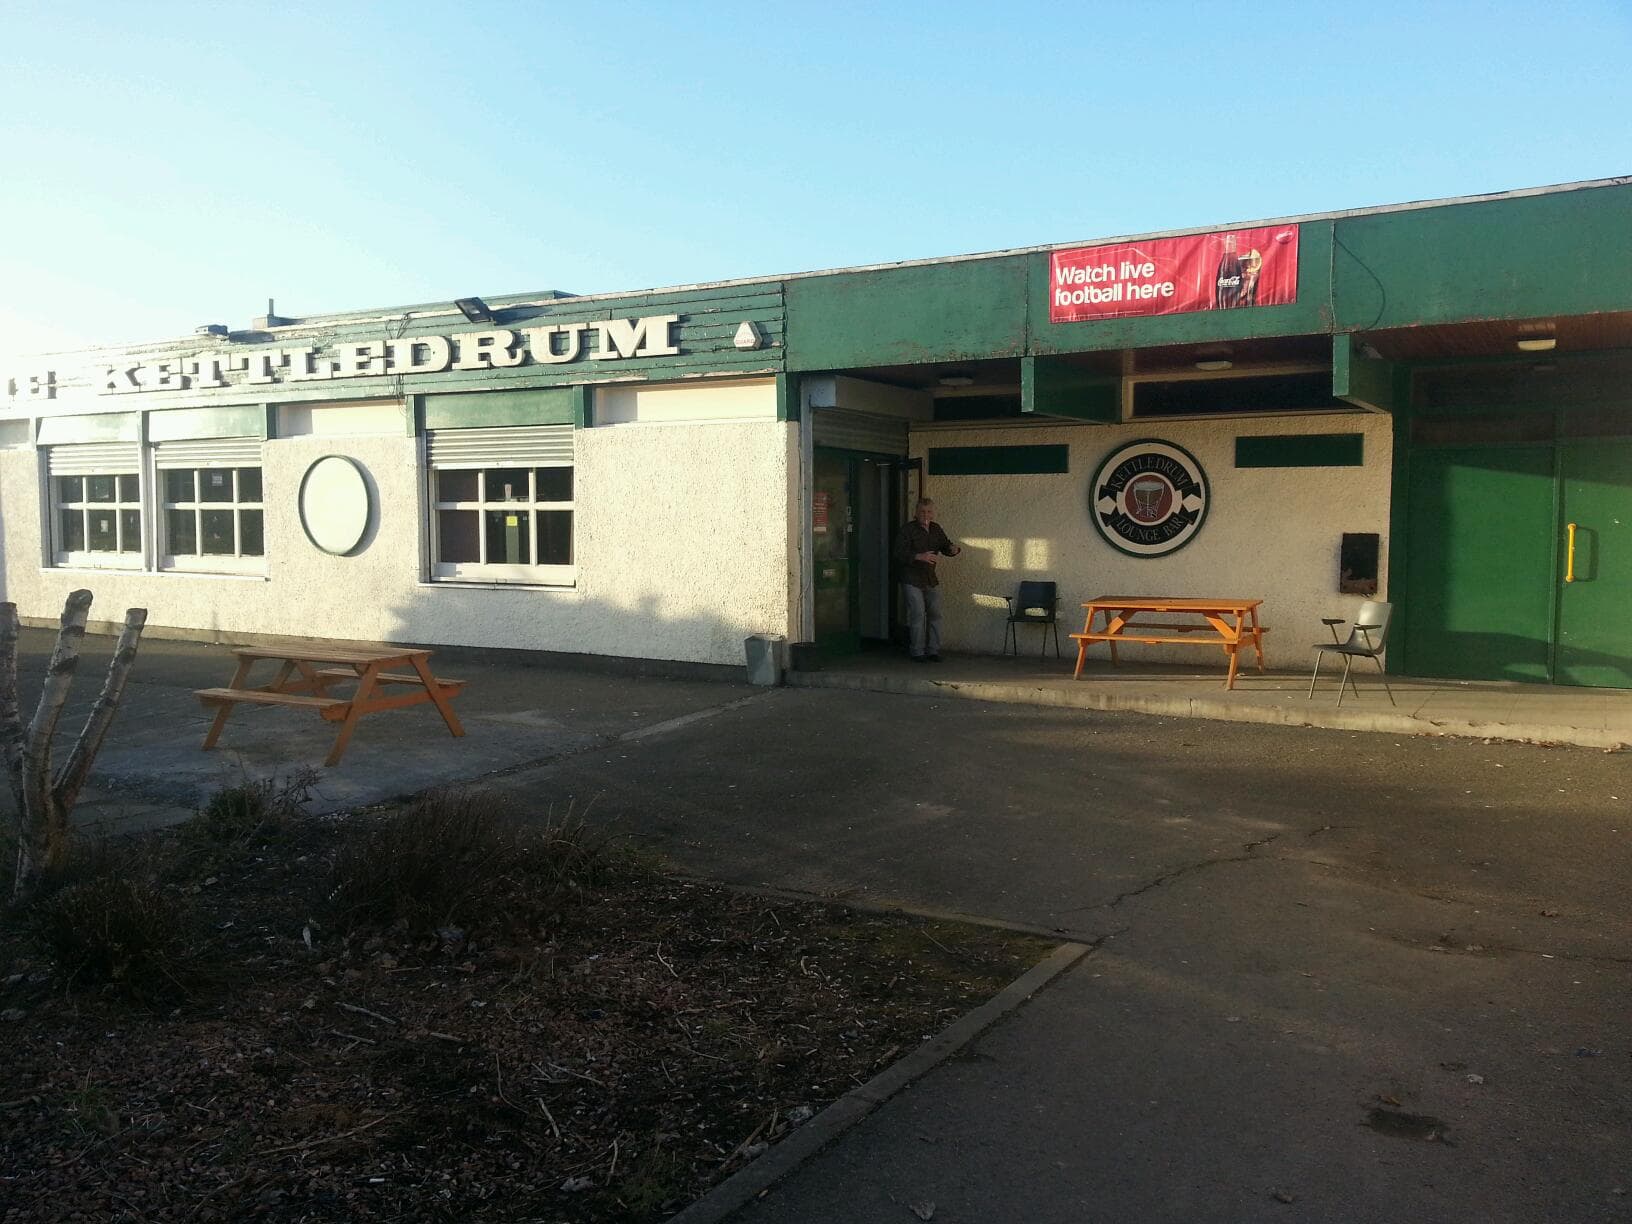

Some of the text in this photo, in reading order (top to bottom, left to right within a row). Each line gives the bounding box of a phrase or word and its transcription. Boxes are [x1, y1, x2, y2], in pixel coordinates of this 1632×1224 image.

[1056, 262, 1155, 285] Watch live
[1055, 280, 1175, 305] football here
[98, 313, 681, 396] KETTLEDRUM
[1110, 456, 1190, 491] KETTLEDRUM
[1116, 517, 1184, 541] LOUNGE BAR
